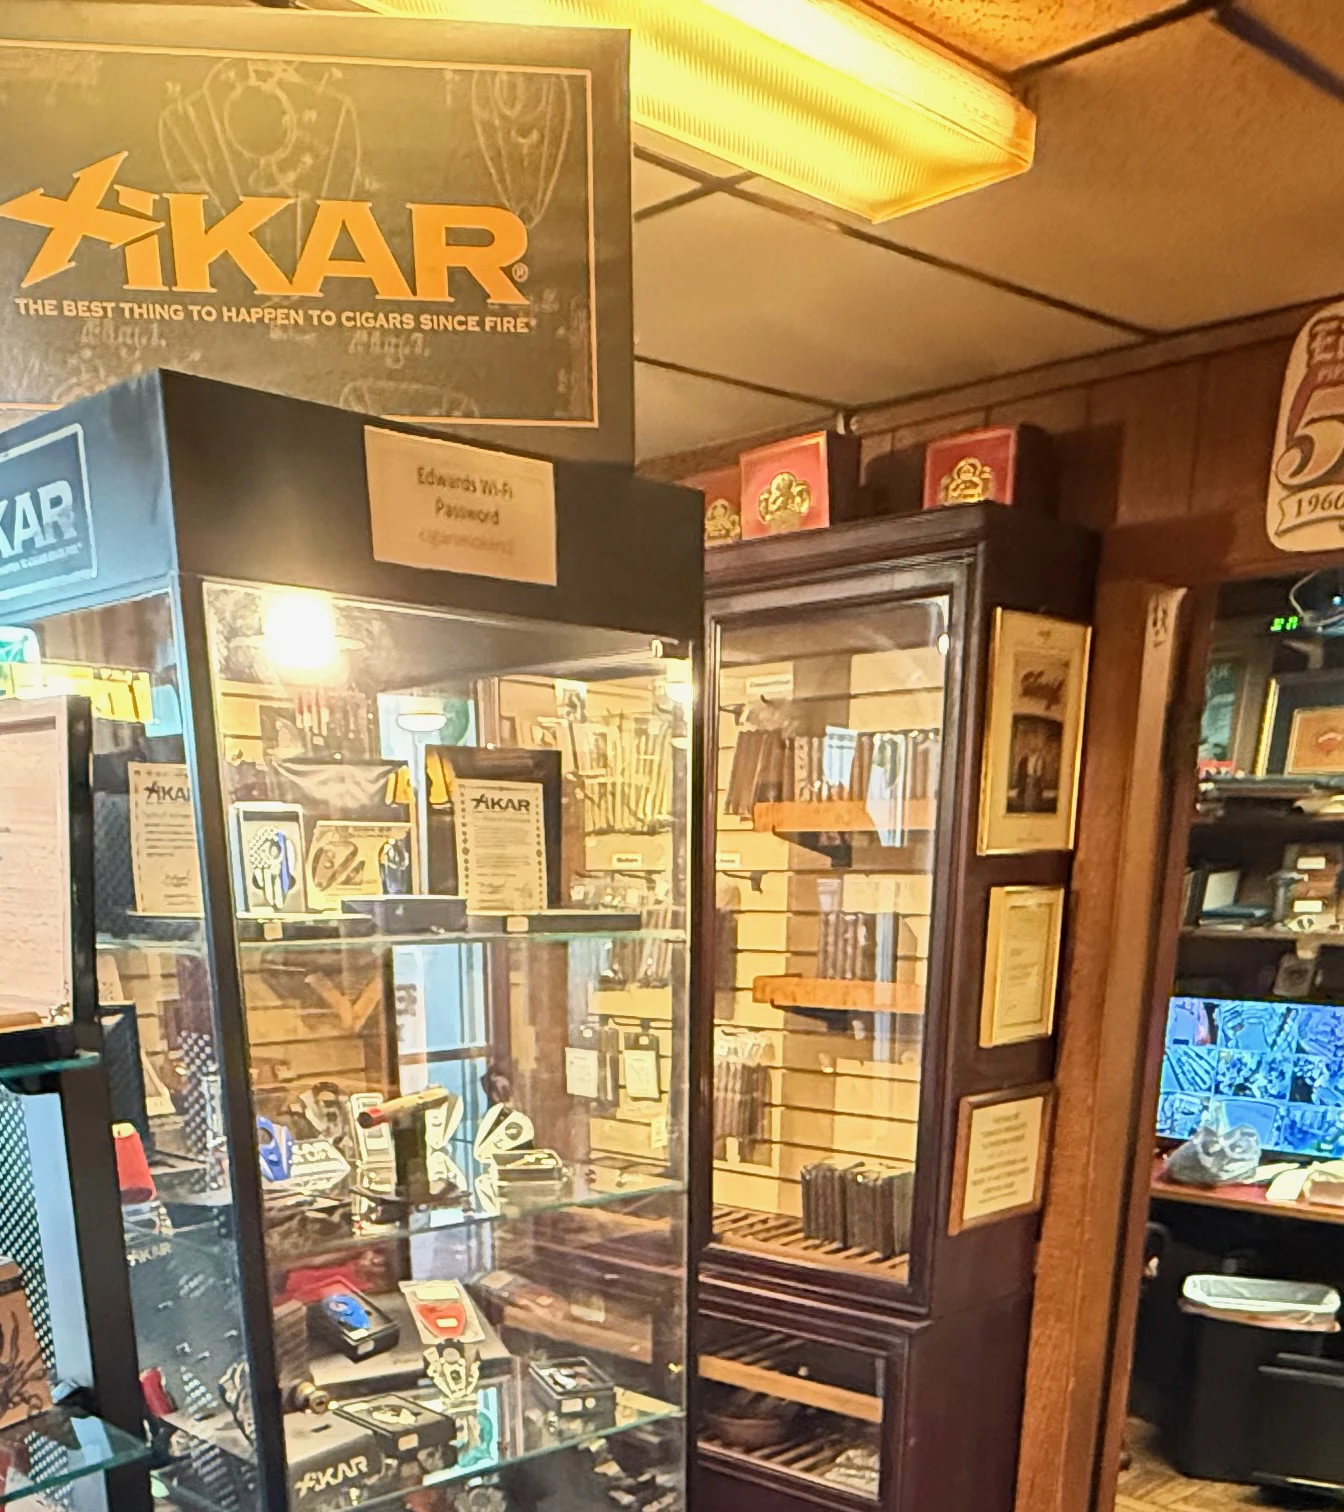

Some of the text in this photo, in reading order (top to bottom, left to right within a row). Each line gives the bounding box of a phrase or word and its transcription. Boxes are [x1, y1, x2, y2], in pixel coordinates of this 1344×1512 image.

[15, 298, 58, 316] THE
[63, 300, 115, 318] BEST
[119, 302, 184, 320] THING
[188, 305, 217, 321] TO
[223, 307, 304, 326] HAPPEN
[308, 310, 336, 326] TO
[341, 311, 414, 329] CIGARS
[419, 315, 479, 331] SINCE
[417, 467, 513, 498] Edwards Wi-Fi
[435, 497, 500, 525] Password
